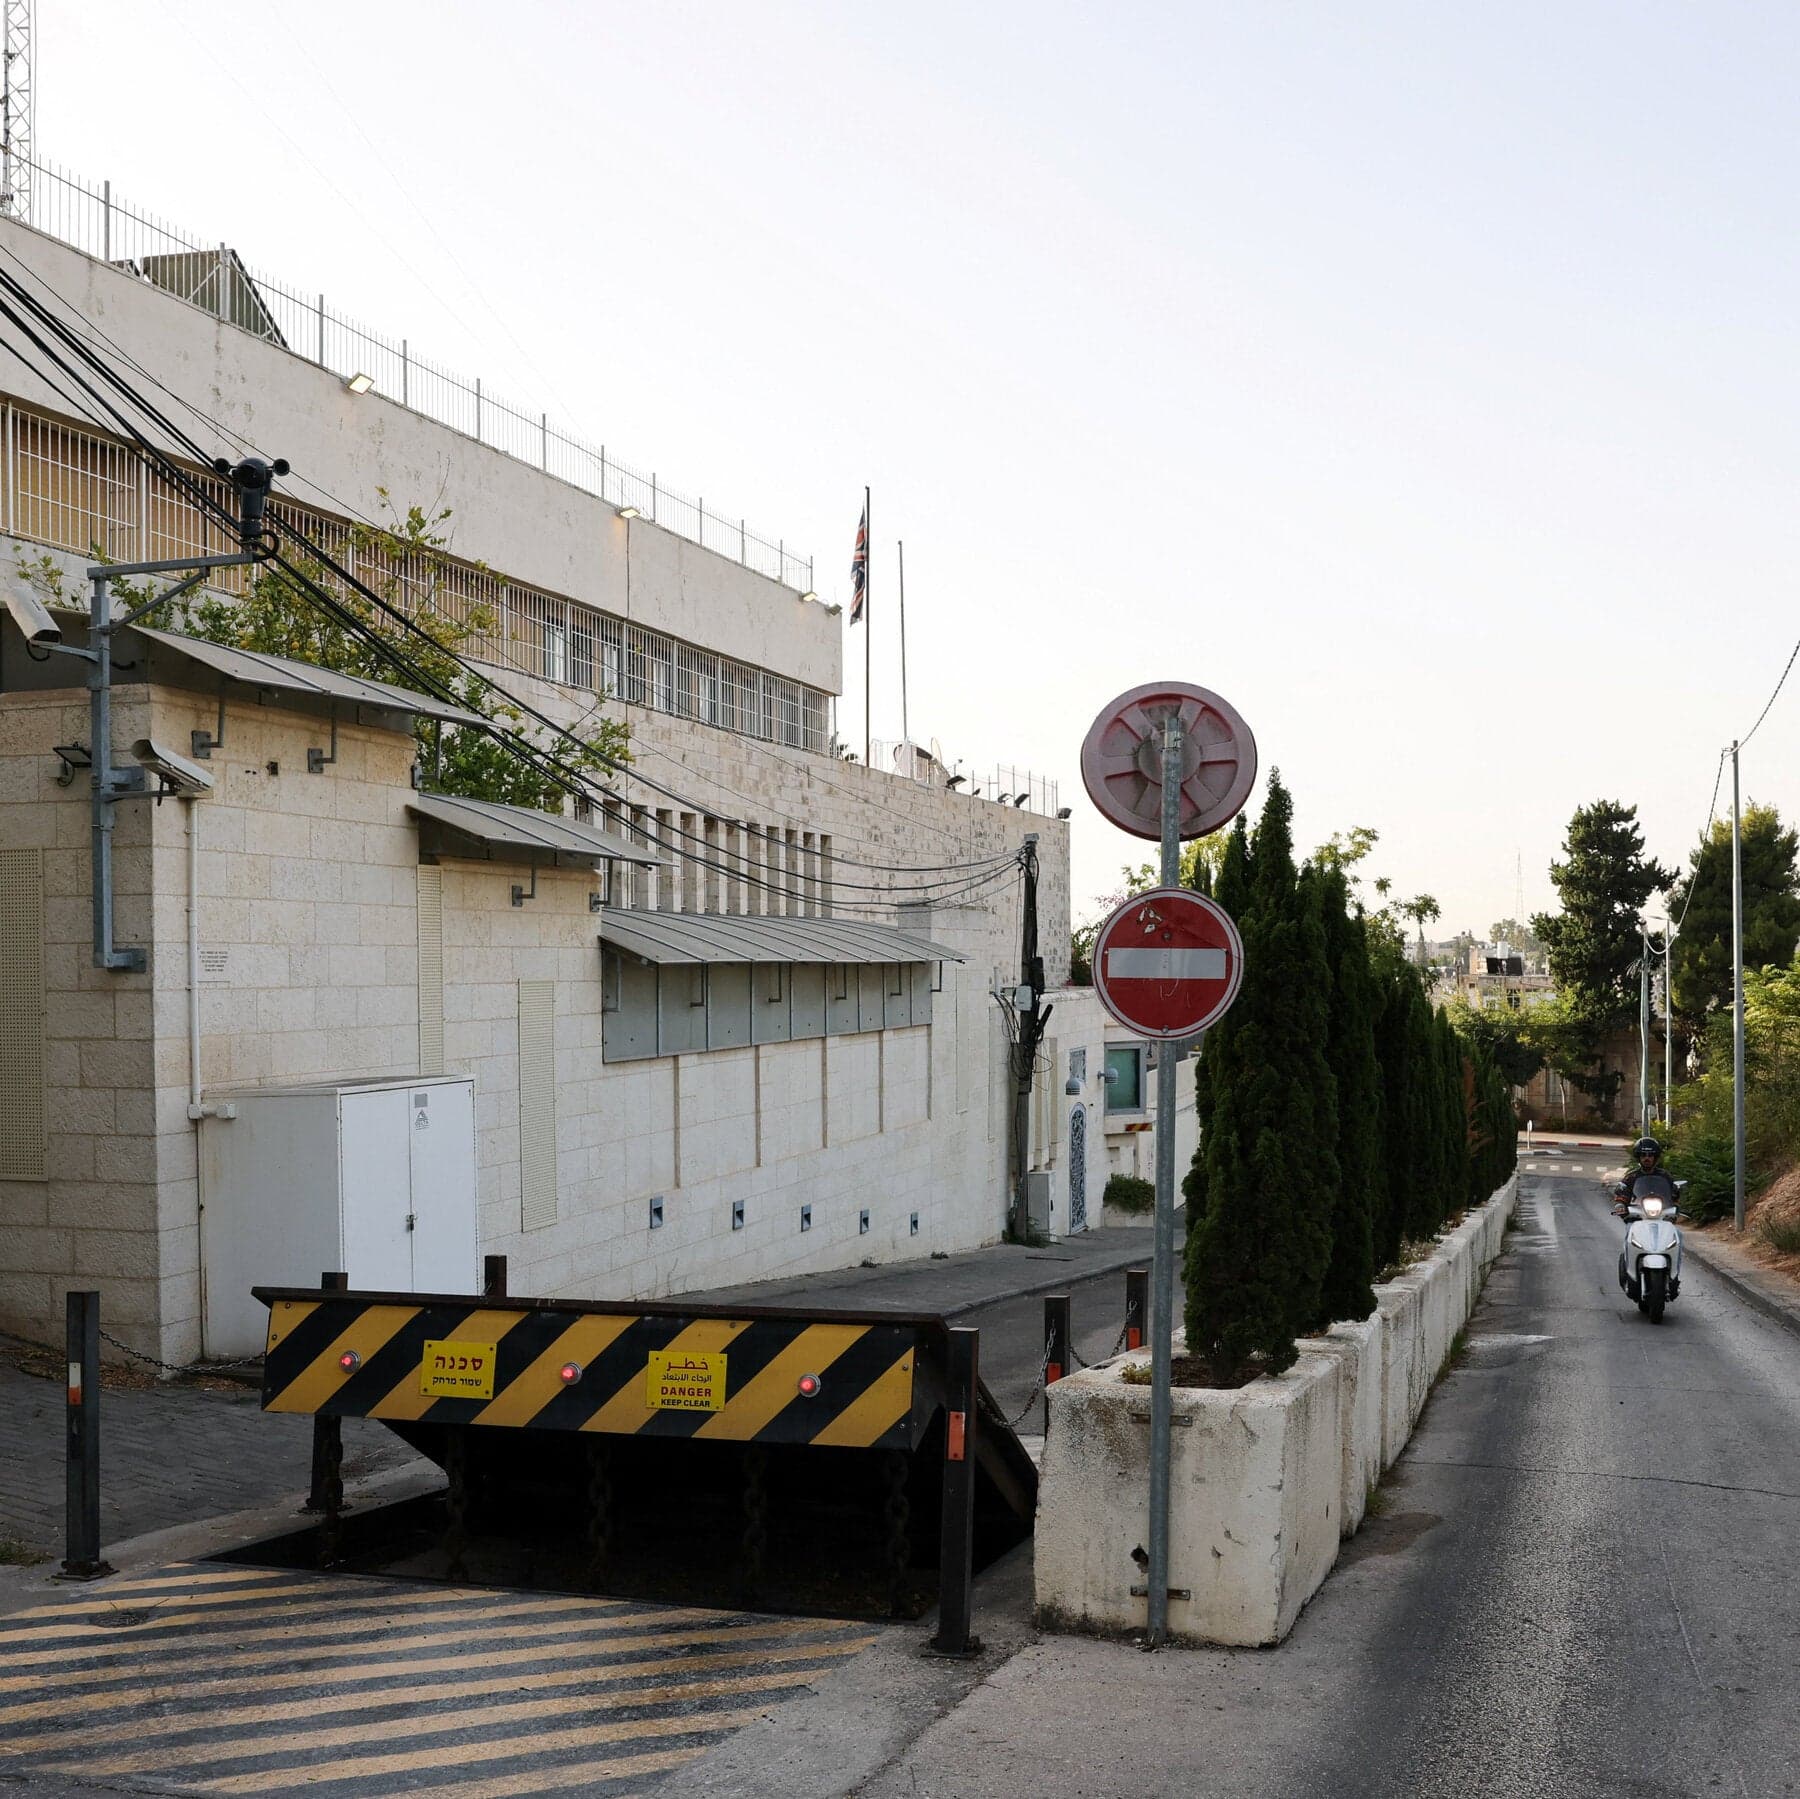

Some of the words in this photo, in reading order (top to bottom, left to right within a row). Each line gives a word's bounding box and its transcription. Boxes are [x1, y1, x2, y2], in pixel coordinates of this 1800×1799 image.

[434, 1355, 483, 1371] סכנה
[666, 1357, 709, 1371] خطر
[432, 1376, 457, 1386] מרחק
[460, 1377, 482, 1386] שמור
[661, 1386, 712, 1397] DANGER
[661, 1398, 682, 1406] KEEP
